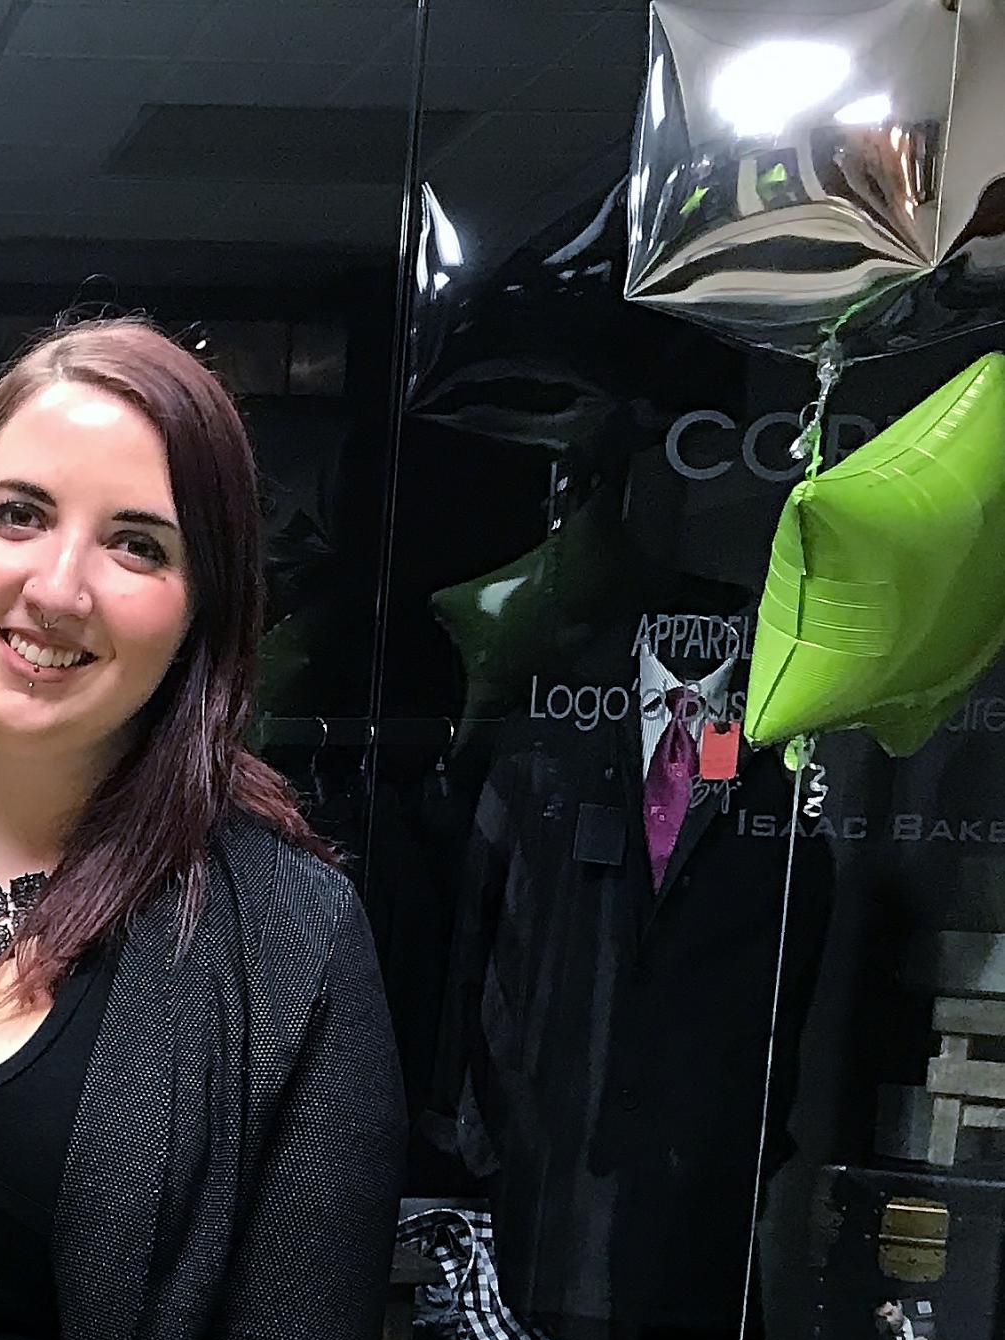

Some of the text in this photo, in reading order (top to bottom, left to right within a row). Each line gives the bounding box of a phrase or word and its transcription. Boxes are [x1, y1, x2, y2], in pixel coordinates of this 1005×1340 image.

[666, 409, 900, 481] COR
[736, 809, 1005, 843] ISAAC BAKE
